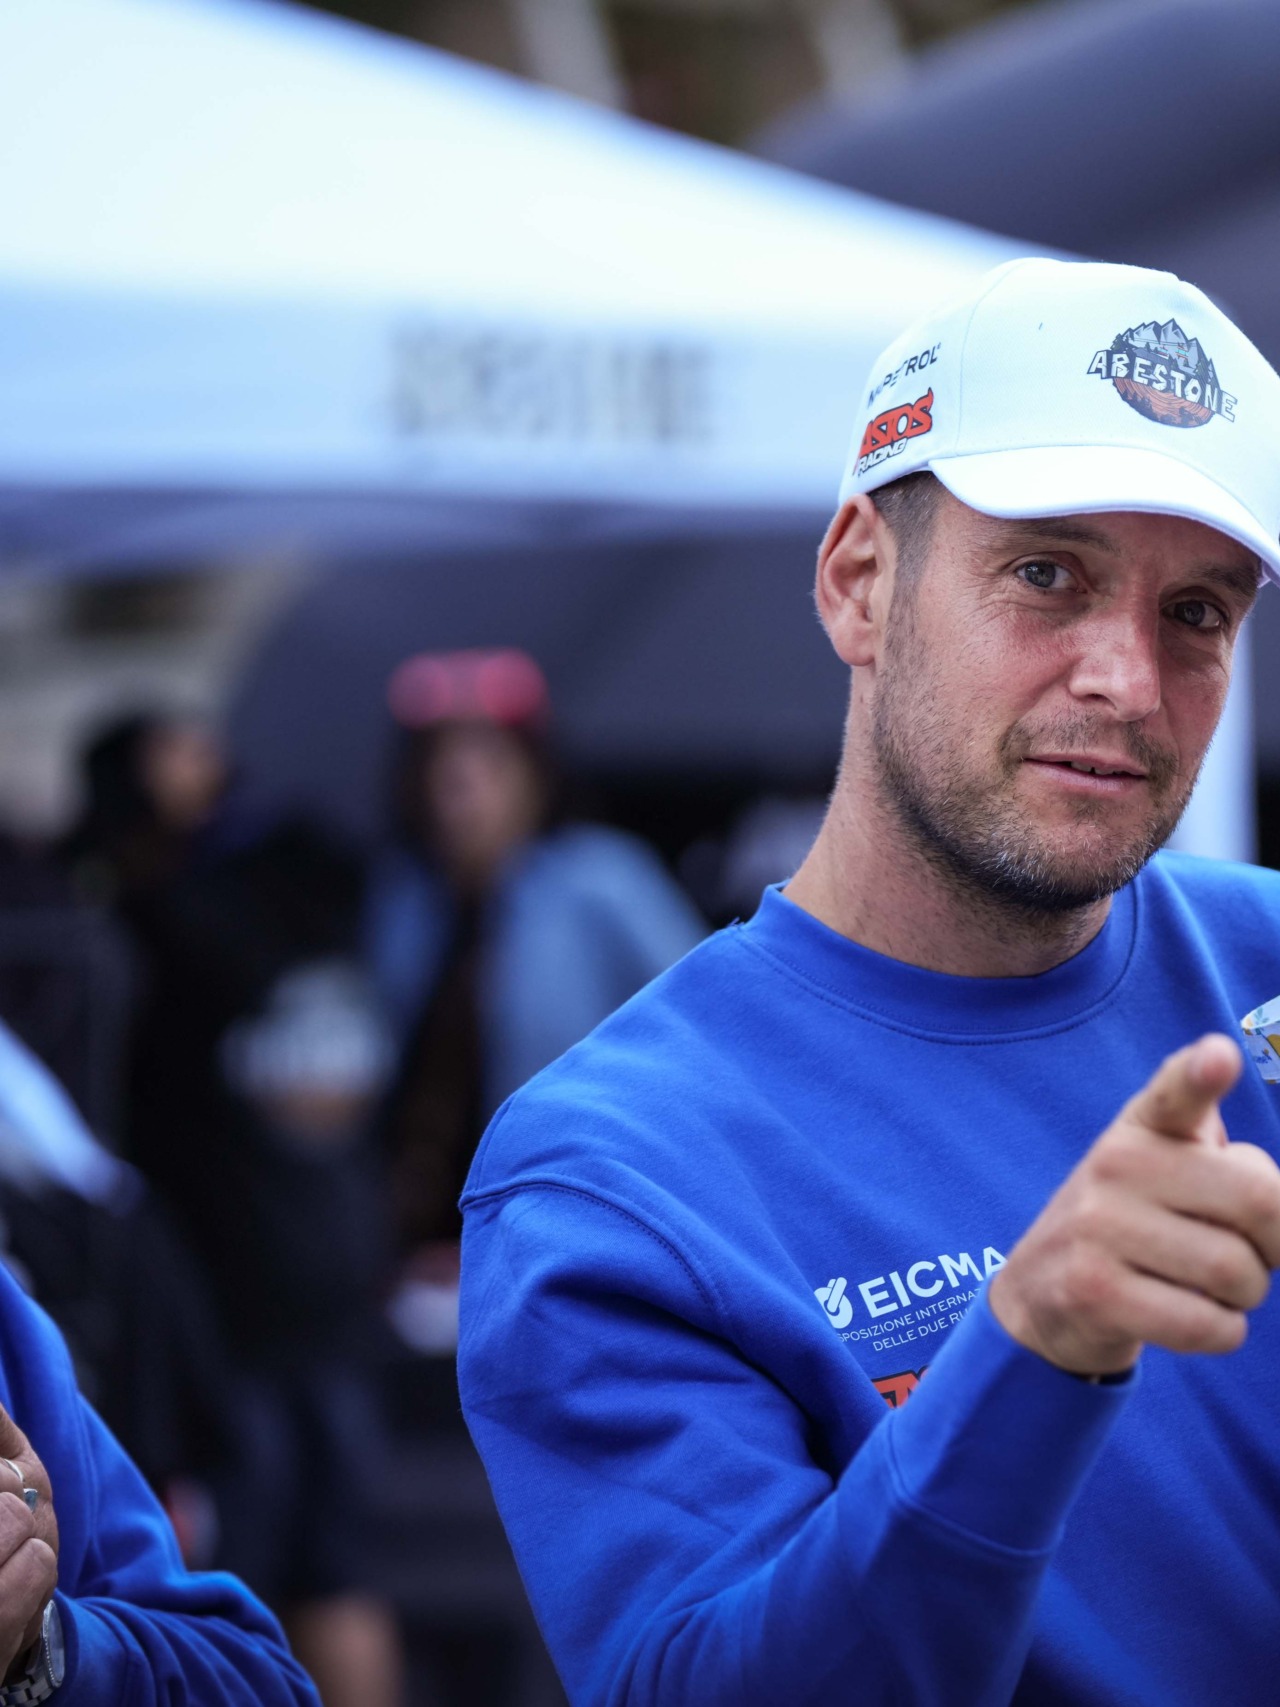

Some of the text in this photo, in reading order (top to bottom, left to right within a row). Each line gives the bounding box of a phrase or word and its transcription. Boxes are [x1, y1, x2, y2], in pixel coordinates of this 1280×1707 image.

[1087, 349, 1239, 423] ABESTONE
[857, 1246, 1008, 1319] EICMA
[836, 1313, 916, 1342] SPOSIZIONE
[872, 1329, 918, 1352] DELLE
[918, 1317, 949, 1337] DUE
